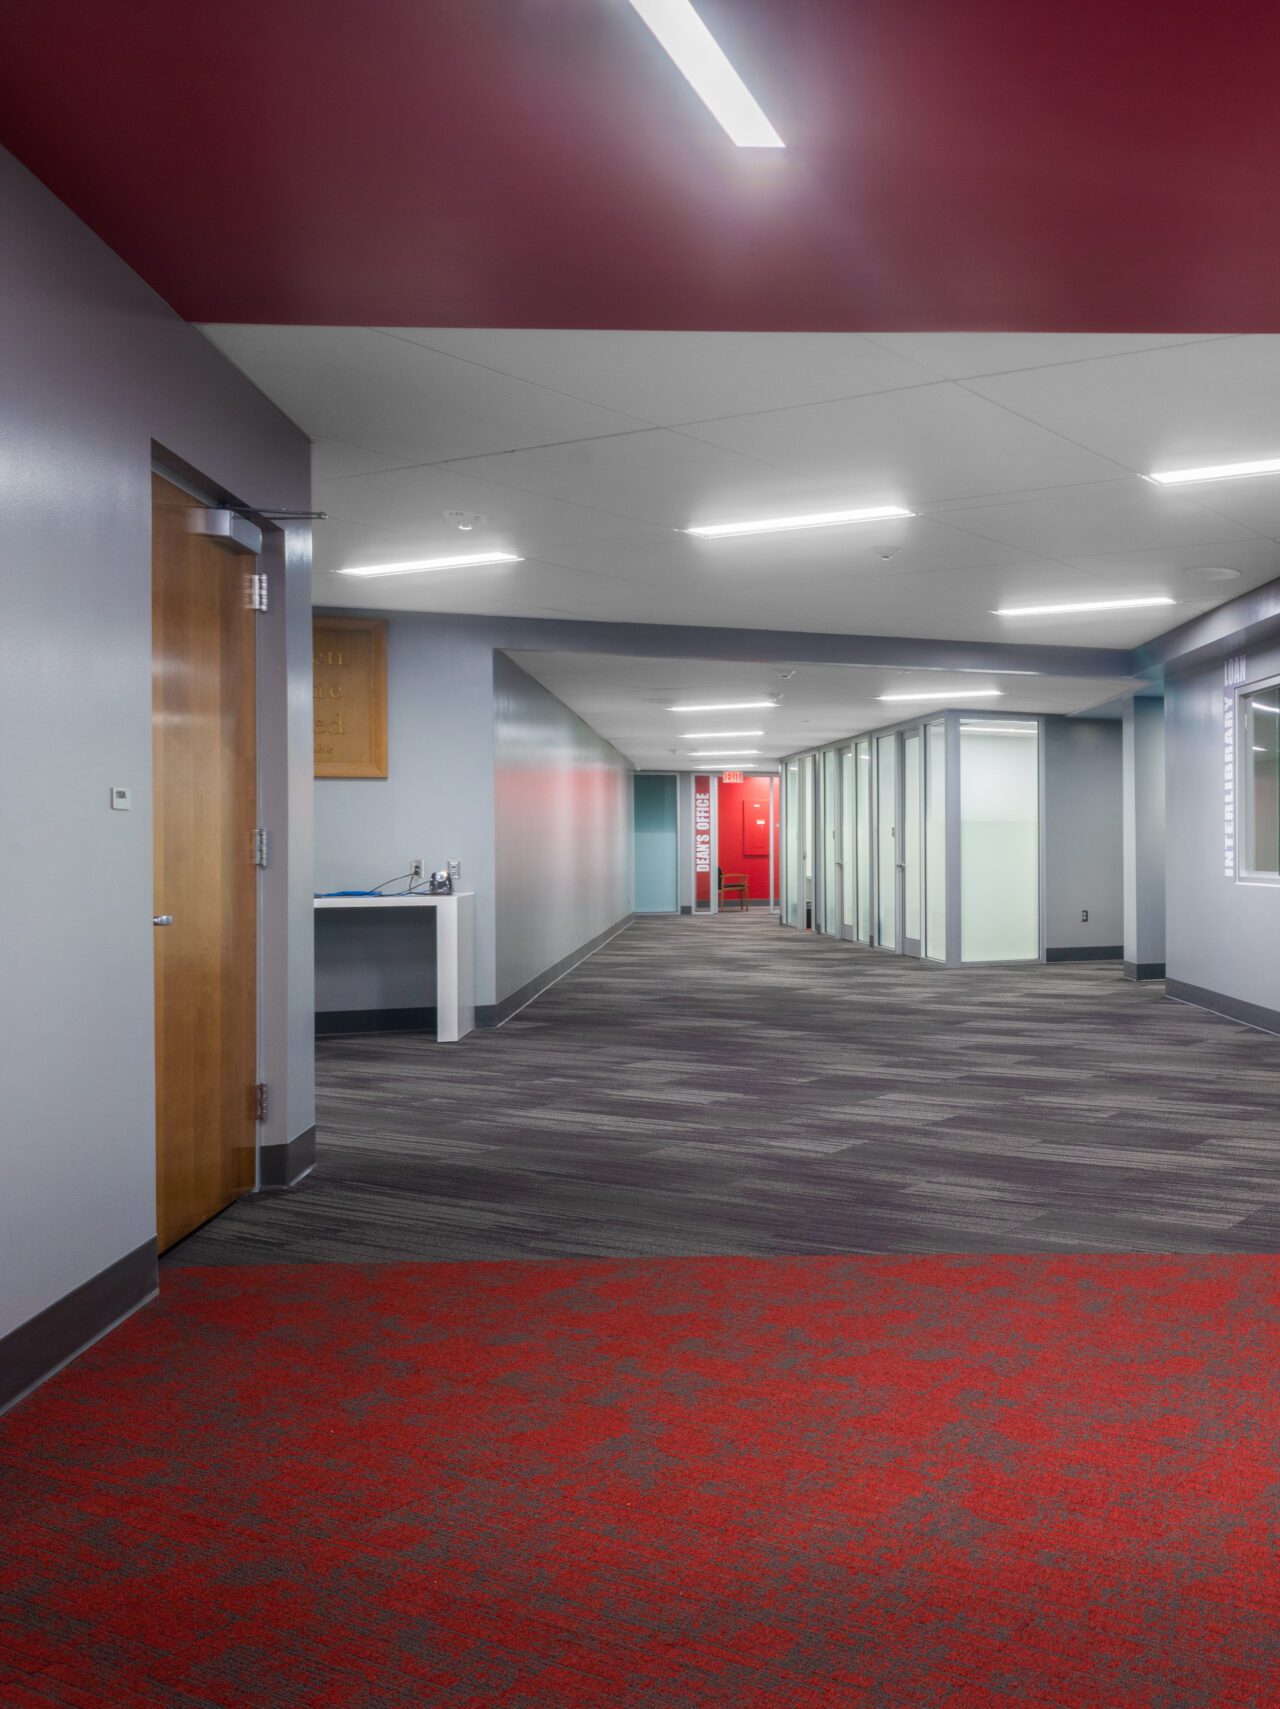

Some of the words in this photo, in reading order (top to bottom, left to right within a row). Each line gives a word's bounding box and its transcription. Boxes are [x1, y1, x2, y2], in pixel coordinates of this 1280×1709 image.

[1224, 655, 1246, 687] LOAN
[726, 771, 742, 783] EXIT
[1224, 697, 1234, 877] INTERLIBRARY
[695, 793, 710, 830] OFFICE
[695, 834, 710, 872] DEAN'S
